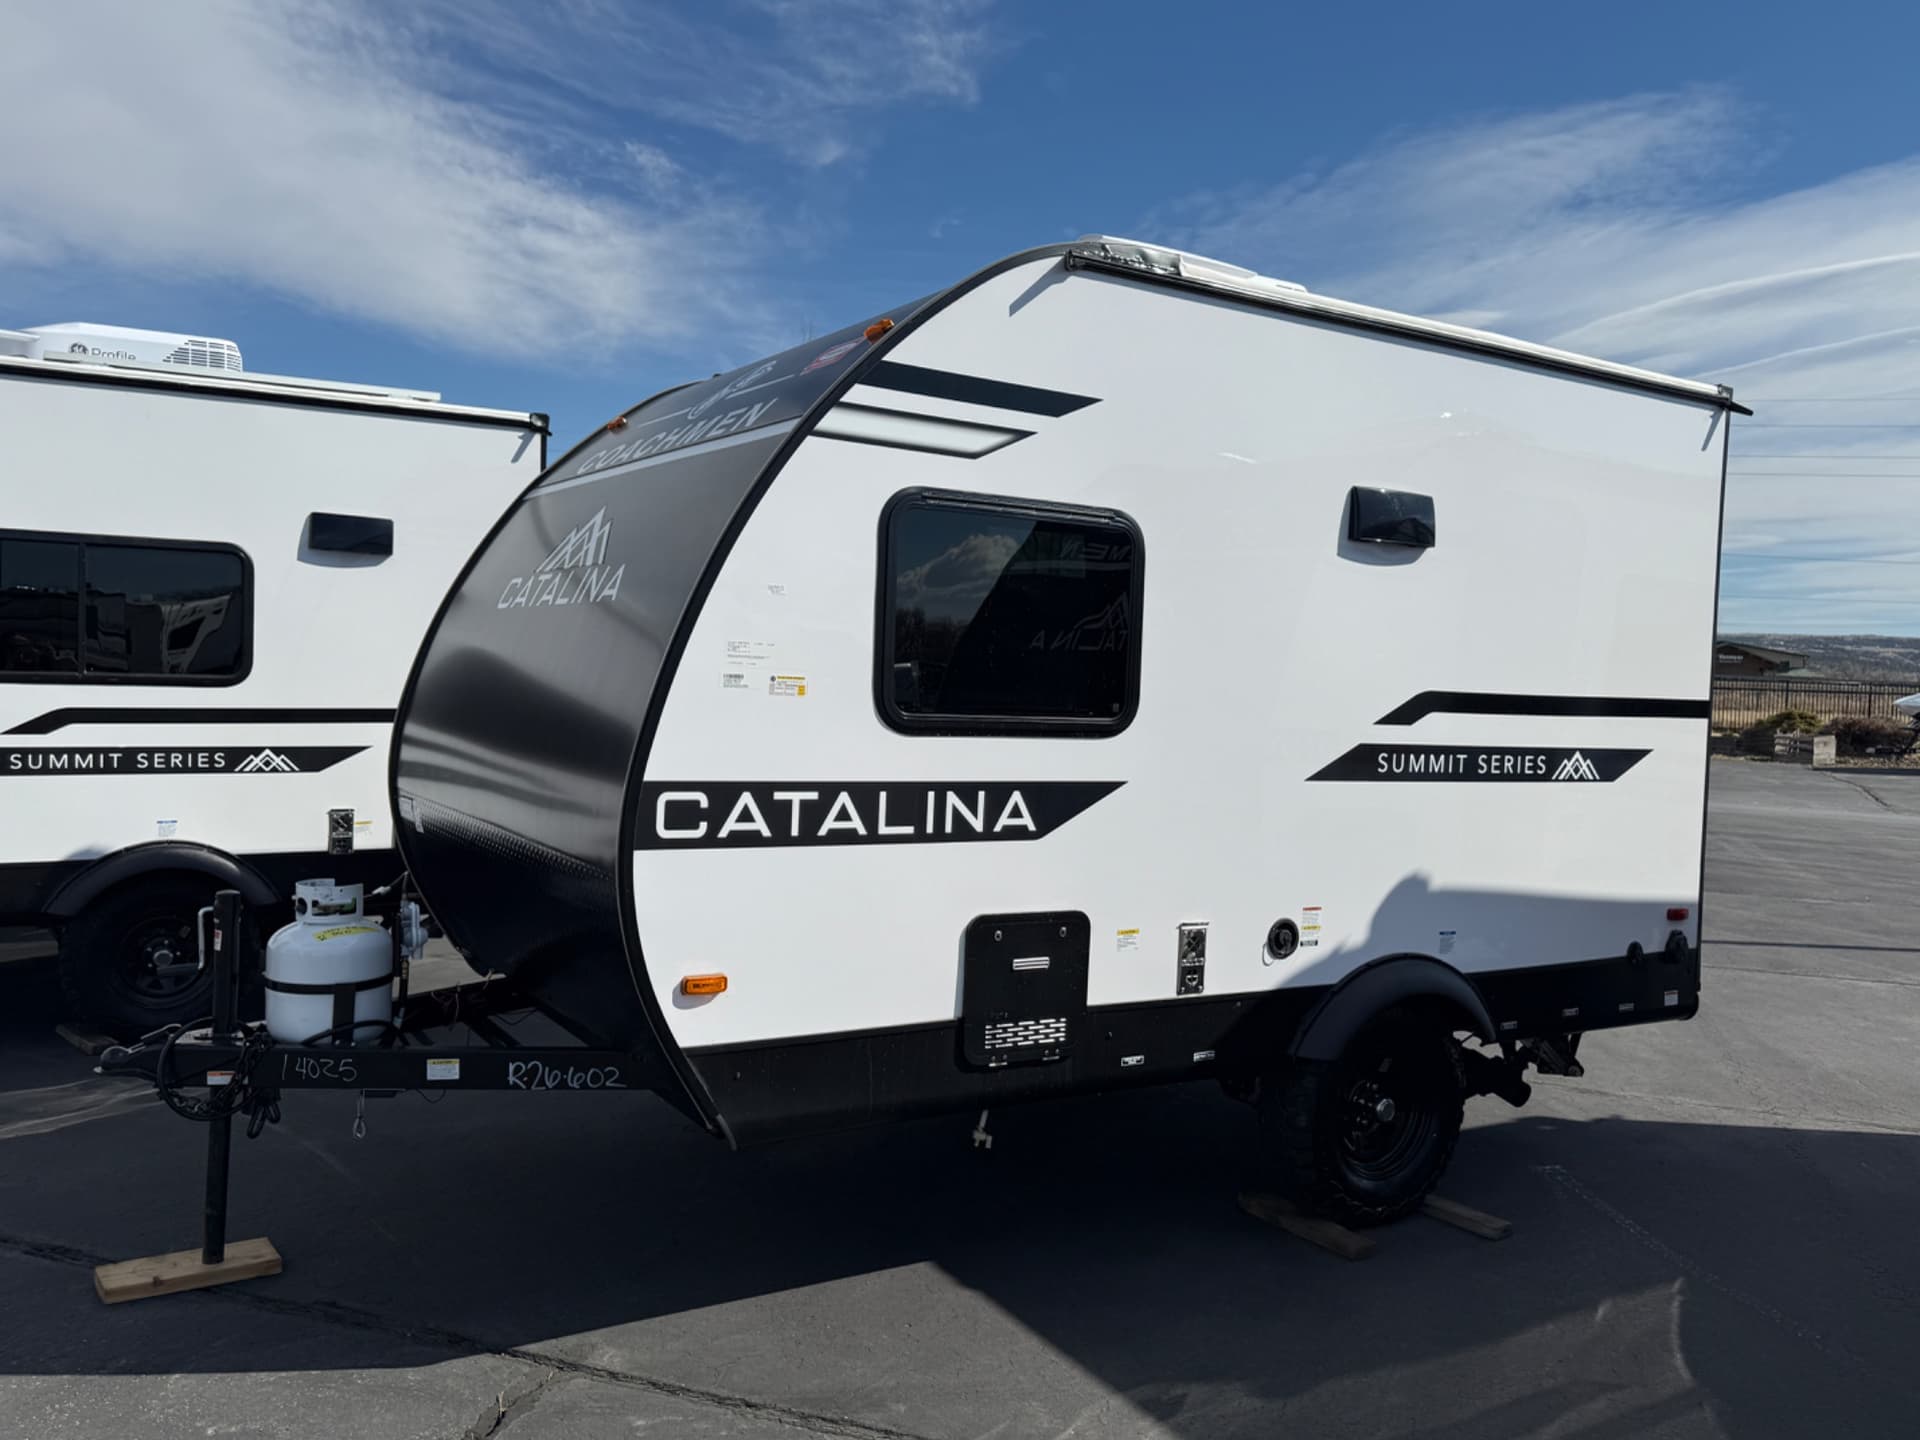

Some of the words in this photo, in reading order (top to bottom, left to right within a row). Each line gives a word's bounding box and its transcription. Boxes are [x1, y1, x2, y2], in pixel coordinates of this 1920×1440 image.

[576, 398, 779, 475] COACHMEN
[496, 563, 626, 610] CATALINA
[9, 753, 123, 770] SUMMIT
[136, 752, 226, 769] SERIES
[1377, 752, 1469, 774] SUMMIT
[1477, 754, 1547, 775] SERIES
[655, 790, 1038, 840] CATALINA
